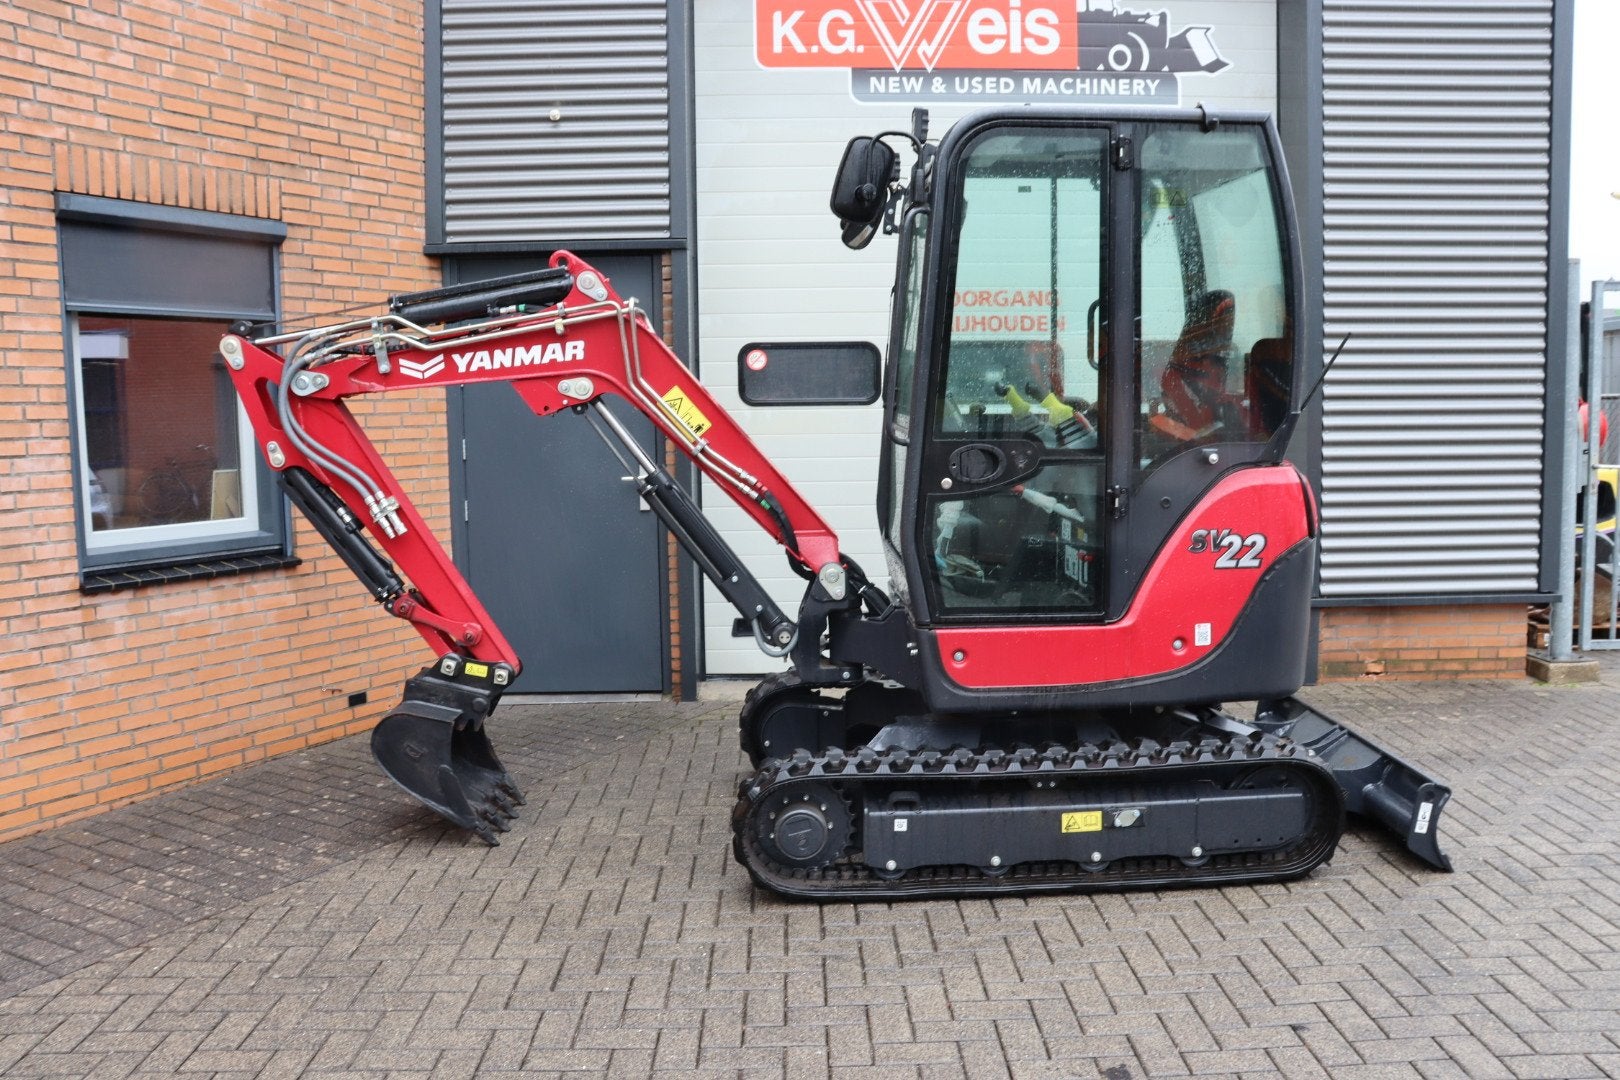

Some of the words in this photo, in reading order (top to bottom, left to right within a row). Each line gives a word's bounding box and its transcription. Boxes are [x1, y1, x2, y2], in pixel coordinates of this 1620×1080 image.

[869, 76, 923, 94] NEW
[931, 76, 947, 94] &
[954, 76, 1015, 94] USED
[1022, 77, 1161, 96] MACHINERY
[951, 315, 1067, 332] IJHOUDEN
[451, 340, 585, 373] YANMAR
[1188, 528, 1267, 569] SV22
